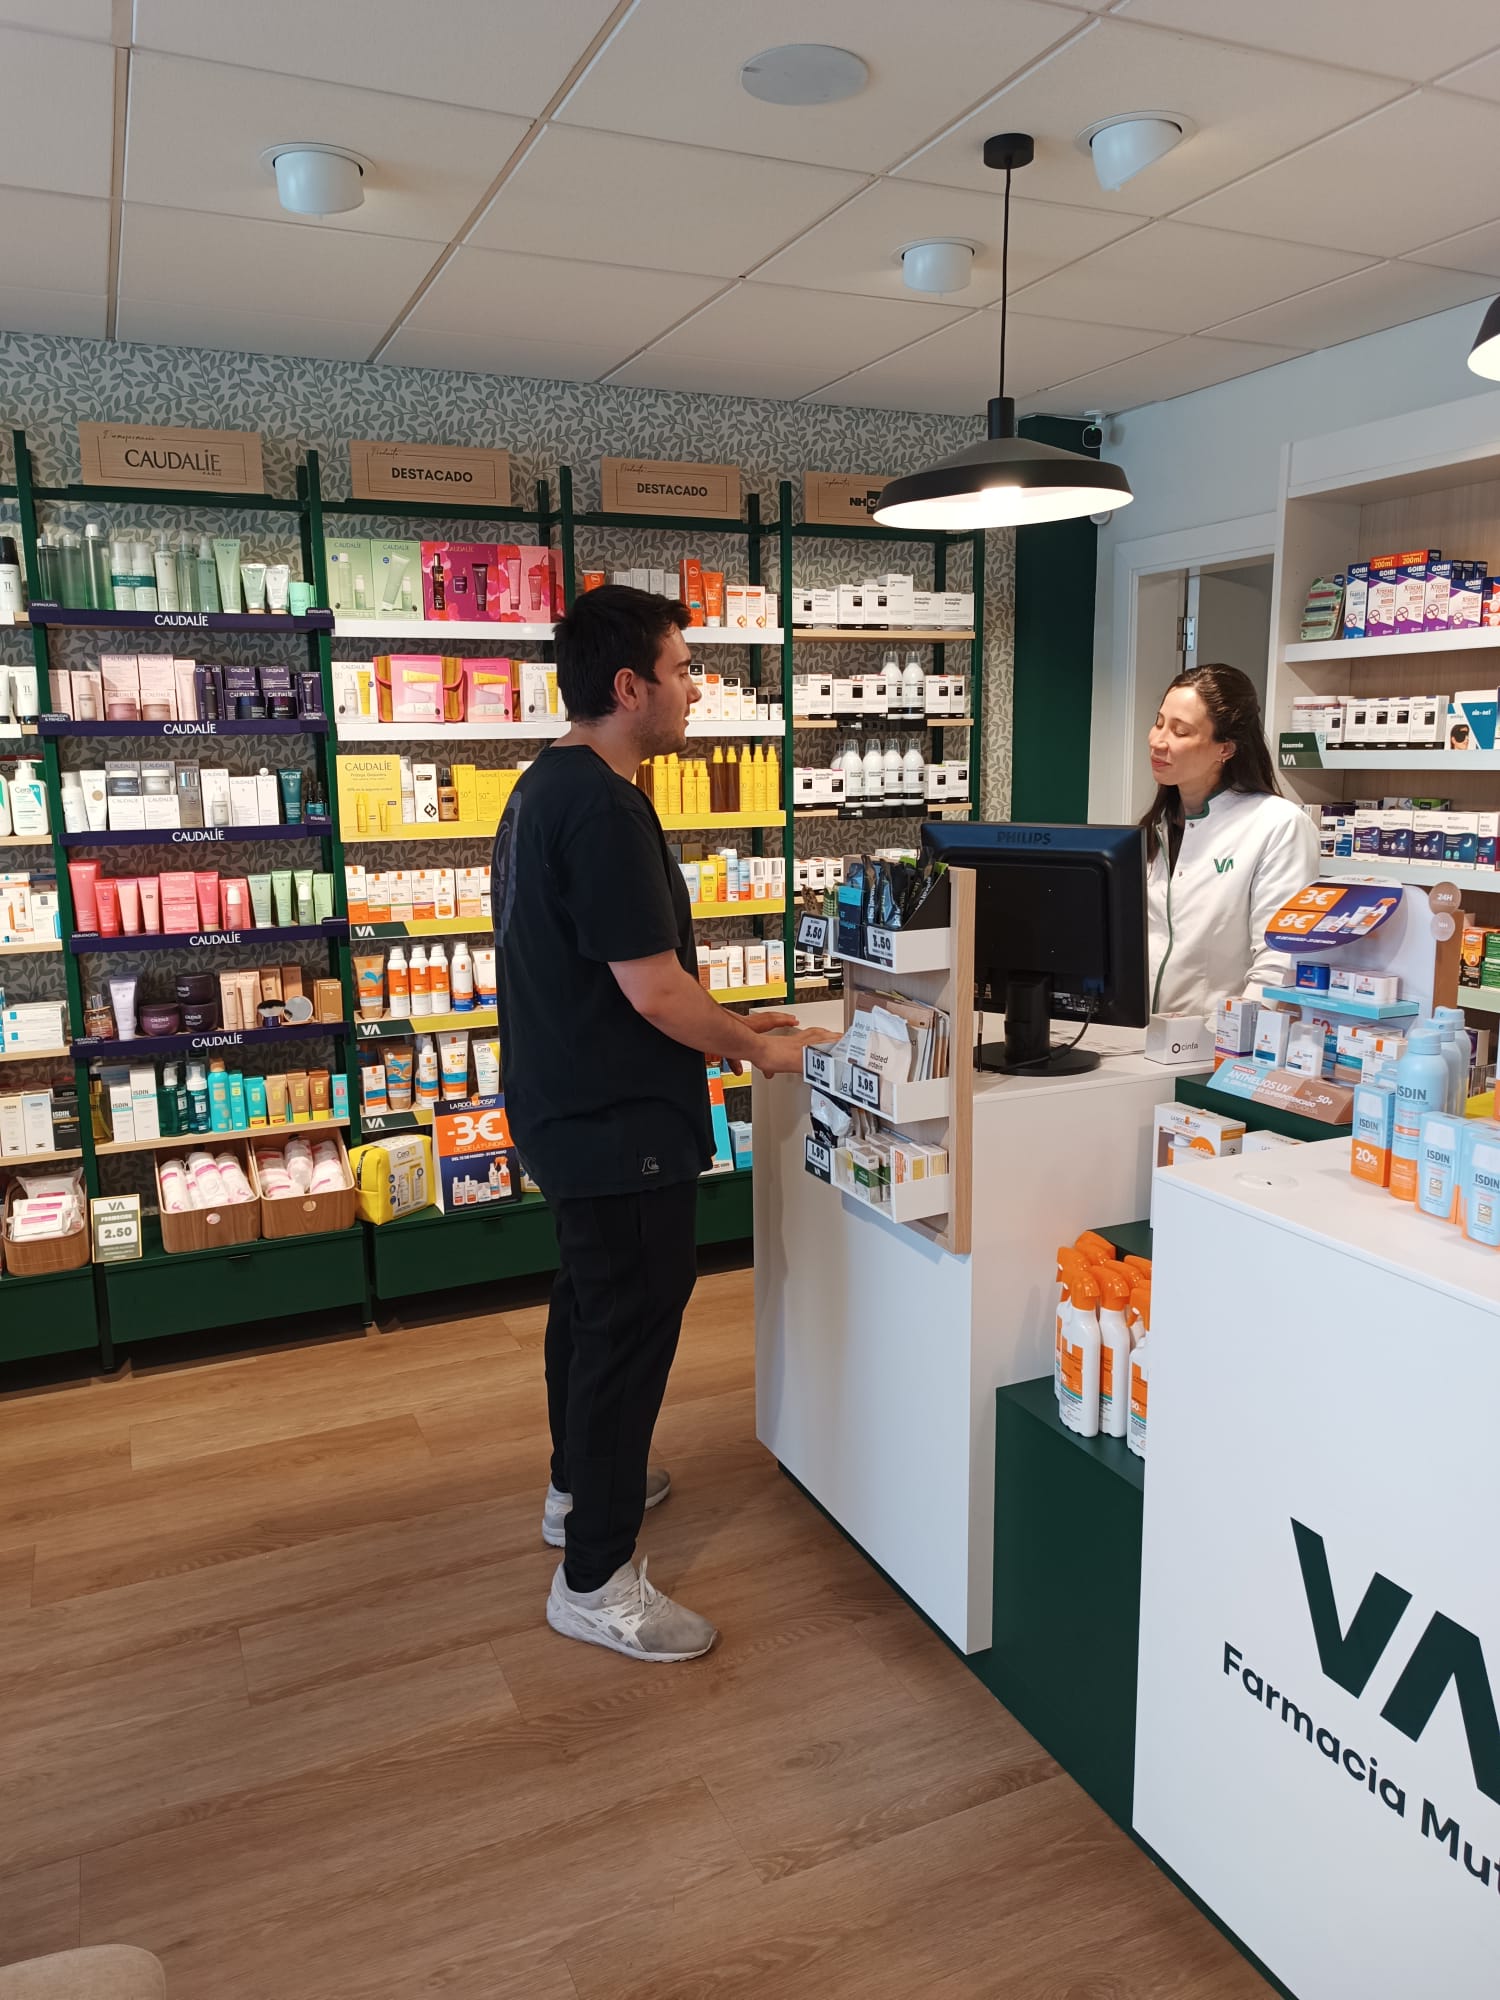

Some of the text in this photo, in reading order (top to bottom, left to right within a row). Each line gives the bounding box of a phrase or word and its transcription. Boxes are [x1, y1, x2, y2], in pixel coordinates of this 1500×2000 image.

[392, 467, 472, 483] DESTACADO
[636, 482, 708, 497] DESTACADO
[1352, 566, 1368, 575] GOIBI
[1379, 569, 1396, 577] GOIBI
[1408, 565, 1426, 573] GOIBI
[1282, 754, 1296, 766] VA
[997, 831, 1052, 845] PHILIPS
[1278, 913, 1315, 929] 8€
[355, 926, 375, 936] VA
[806, 924, 822, 939] 3.50
[873, 934, 891, 951] 3.50
[361, 1024, 381, 1036] VA
[1181, 1042, 1199, 1050] cinfa
[812, 1055, 824, 1072] 1.95
[858, 1075, 873, 1093] 3.95
[1226, 1070, 1277, 1089] ANTHELIOS
[1278, 1082, 1292, 1092] UV
[1316, 1094, 1333, 1105] 50+
[1396, 1085, 1427, 1100] ISDIN
[366, 1118, 385, 1129] VA
[1359, 1118, 1379, 1132] ISDIN
[812, 1144, 824, 1160] 1.95
[1355, 1146, 1378, 1167] 20%
[1427, 1149, 1450, 1164] ISDIN
[1475, 1173, 1500, 1189] ISDIN
[108, 1201, 125, 1210] VA
[104, 1226, 132, 1238] 2.50
[1223, 1640, 1500, 1895] Farmacia Mu
